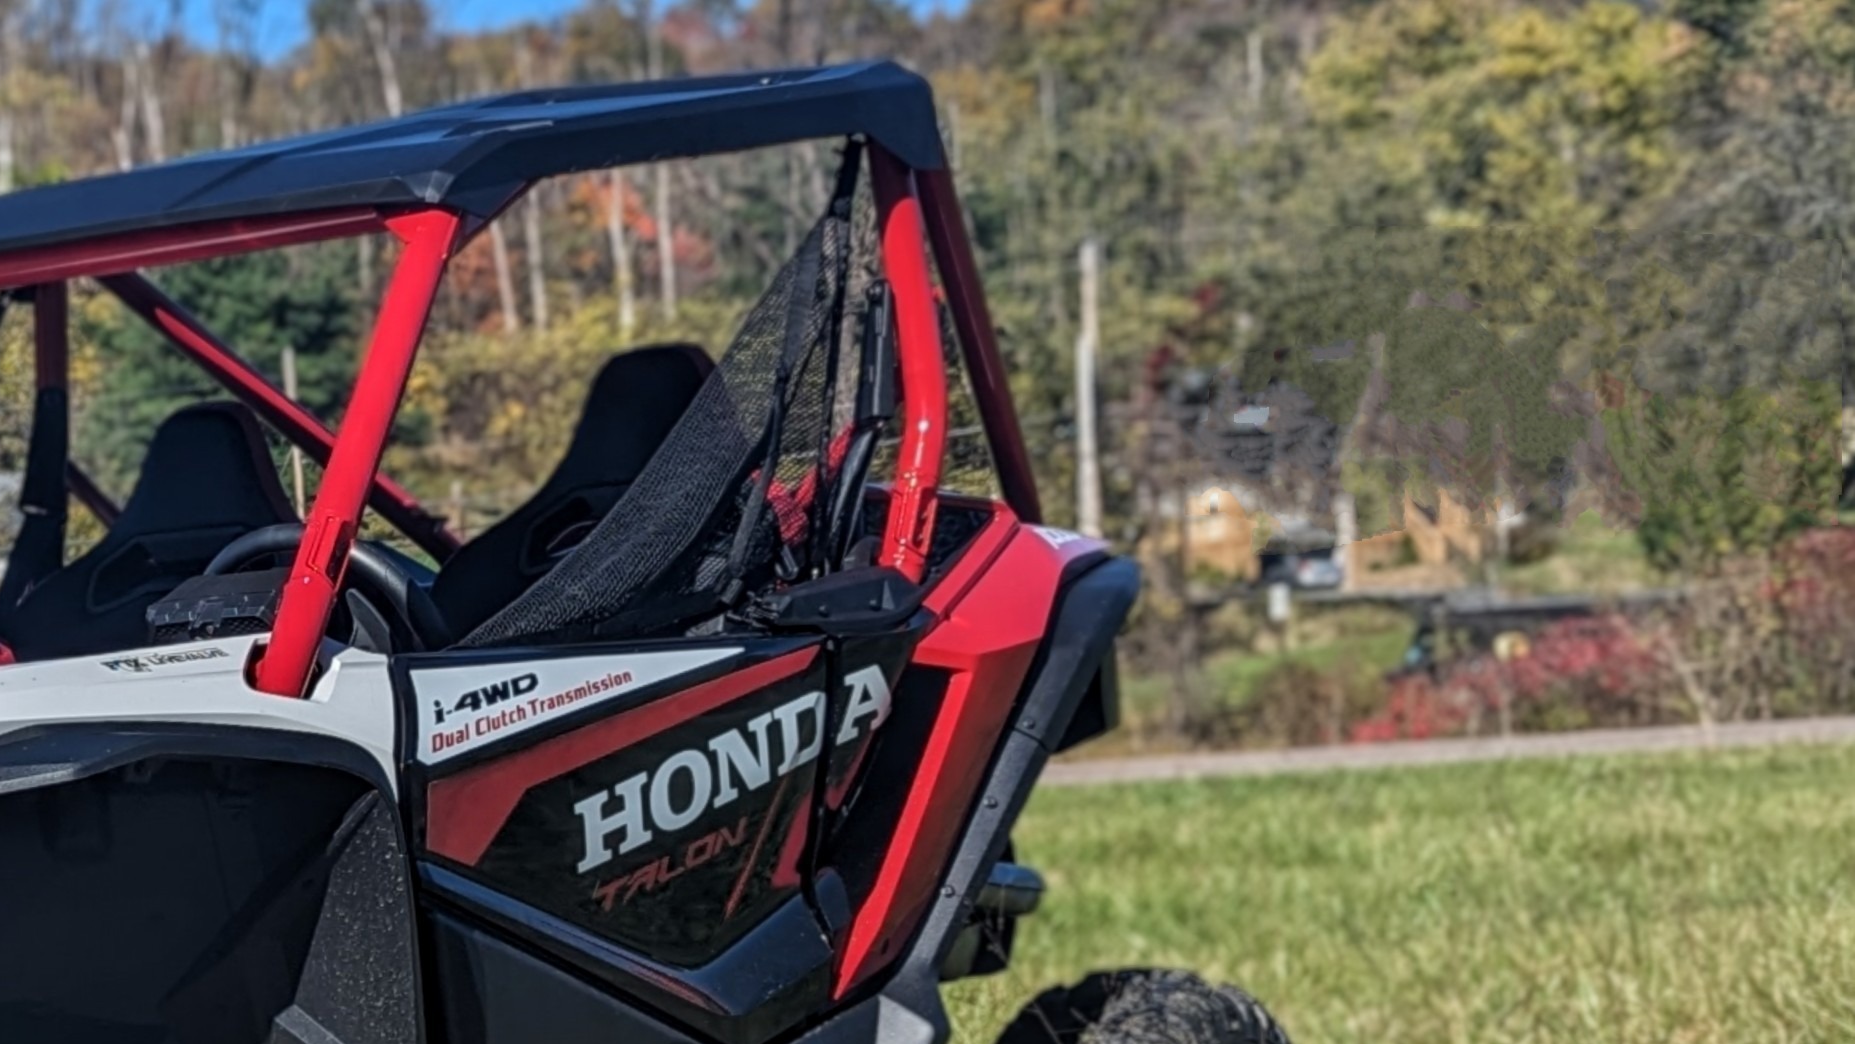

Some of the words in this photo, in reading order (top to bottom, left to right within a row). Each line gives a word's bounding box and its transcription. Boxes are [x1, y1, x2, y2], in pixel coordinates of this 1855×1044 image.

[431, 723, 470, 753] Dual
[475, 703, 527, 737] Clutch
[528, 671, 633, 717] Transmission
[433, 672, 539, 725] i-4WD
[573, 664, 892, 874] HONDA
[594, 817, 748, 913] TALON
